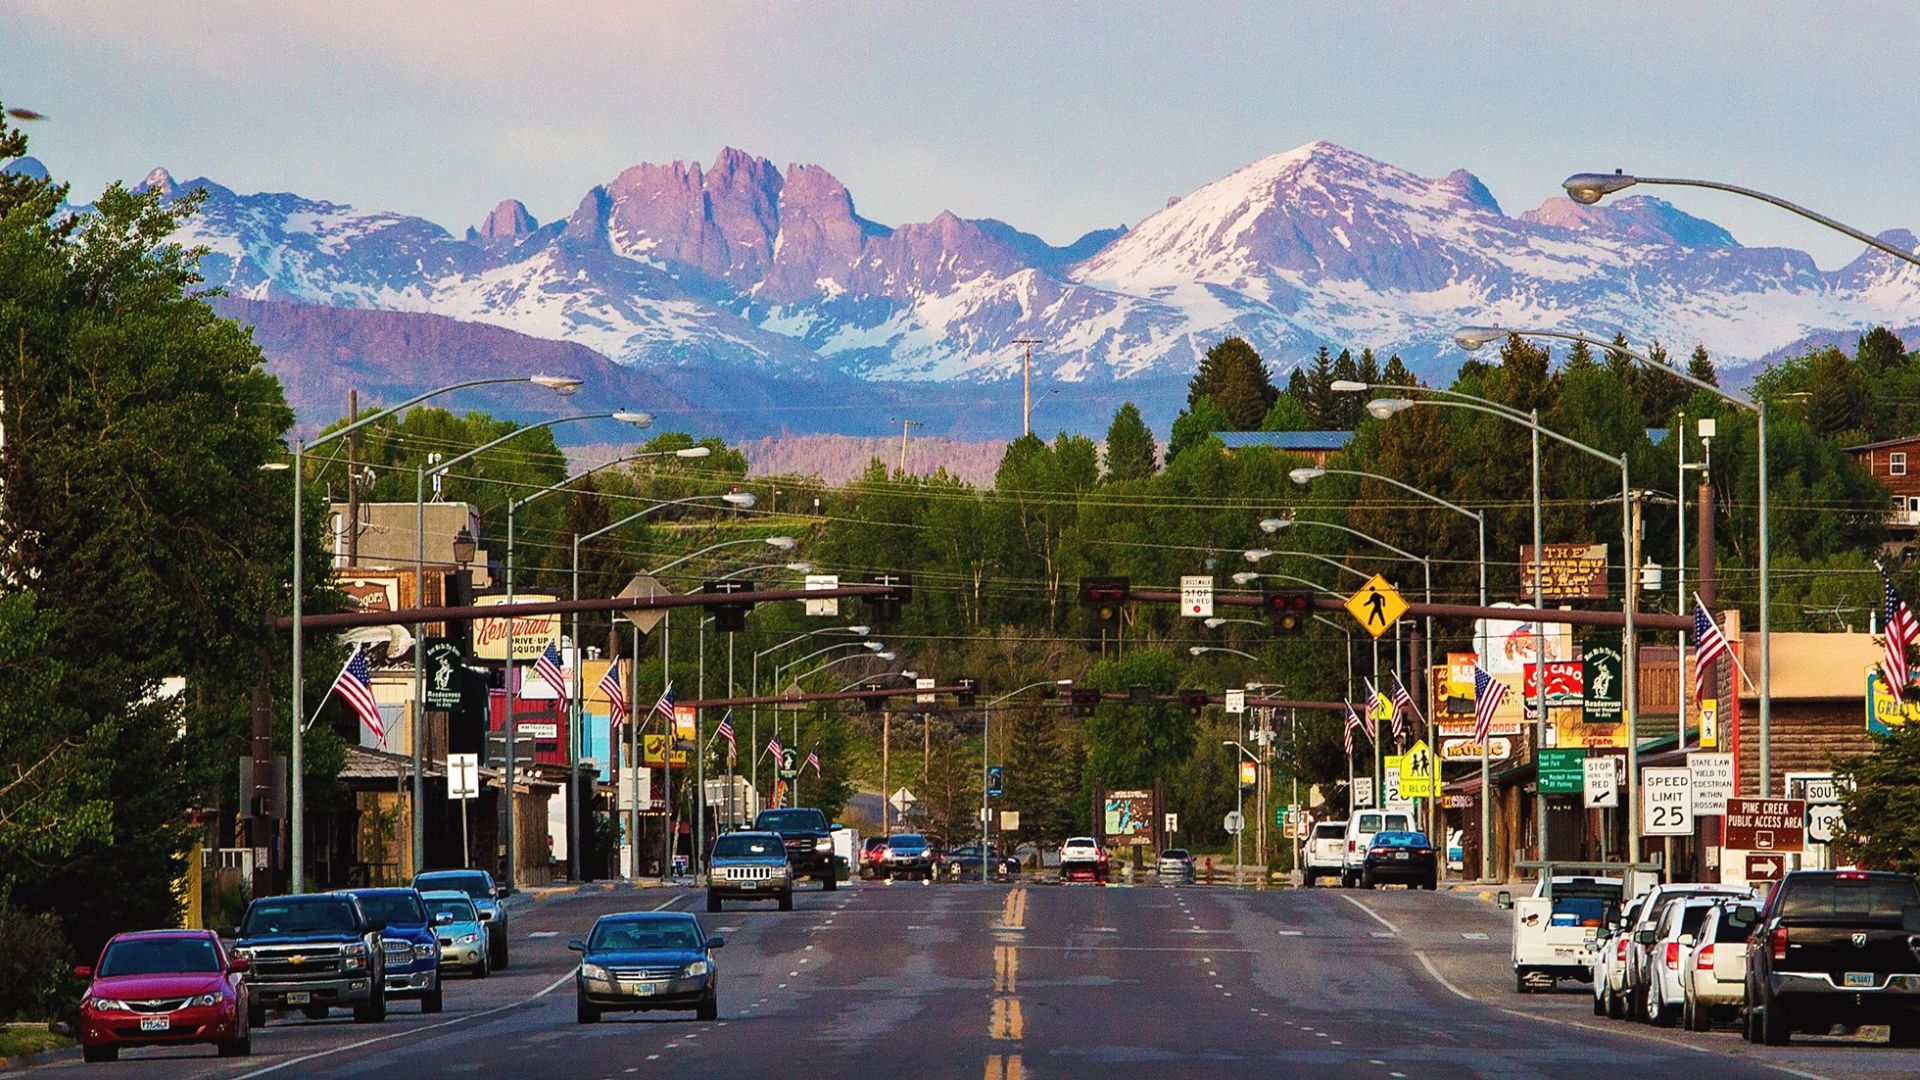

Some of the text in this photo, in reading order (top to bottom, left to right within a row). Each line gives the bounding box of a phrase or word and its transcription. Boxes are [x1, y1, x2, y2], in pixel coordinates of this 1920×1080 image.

[1545, 547, 1583, 558] THE
[1527, 560, 1604, 574] COWBOY
[1185, 589, 1209, 597] STOP
[1588, 763, 1611, 771] STOP
[1591, 780, 1609, 788] RED
[1647, 777, 1688, 787] SPEED
[1652, 792, 1683, 802] LIMIT
[1742, 802, 1789, 815] PINE CREEK
[1653, 806, 1684, 827] 25
[1728, 816, 1803, 829] PUBLIC ACCESS AREA
